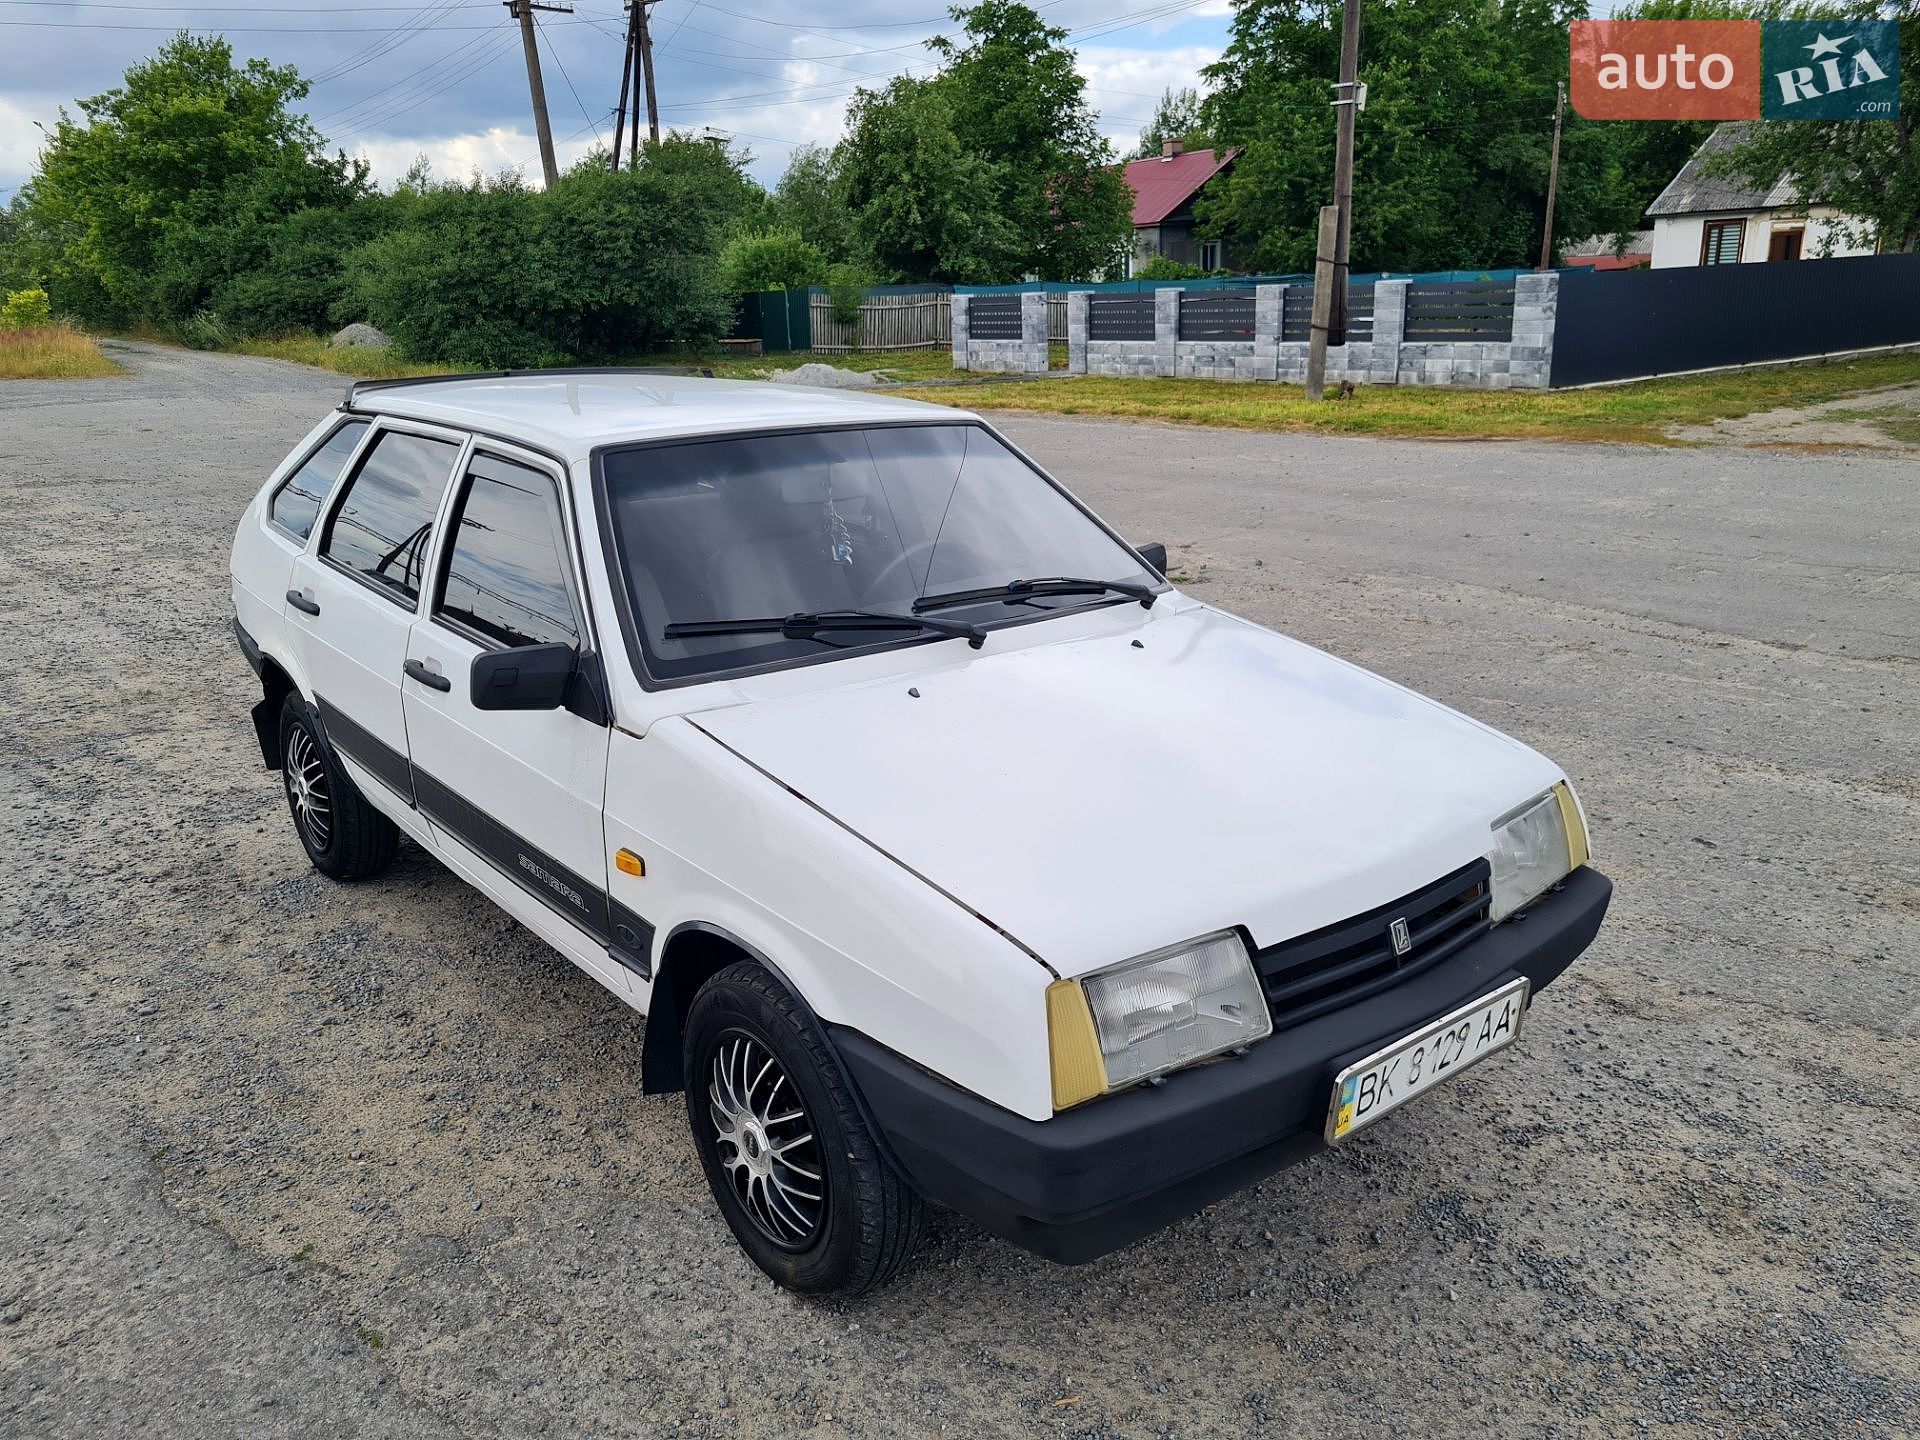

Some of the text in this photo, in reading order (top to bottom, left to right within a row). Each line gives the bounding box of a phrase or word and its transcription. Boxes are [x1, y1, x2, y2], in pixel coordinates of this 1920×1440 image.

[1356, 1000, 1511, 1116] BK 8129 AA
